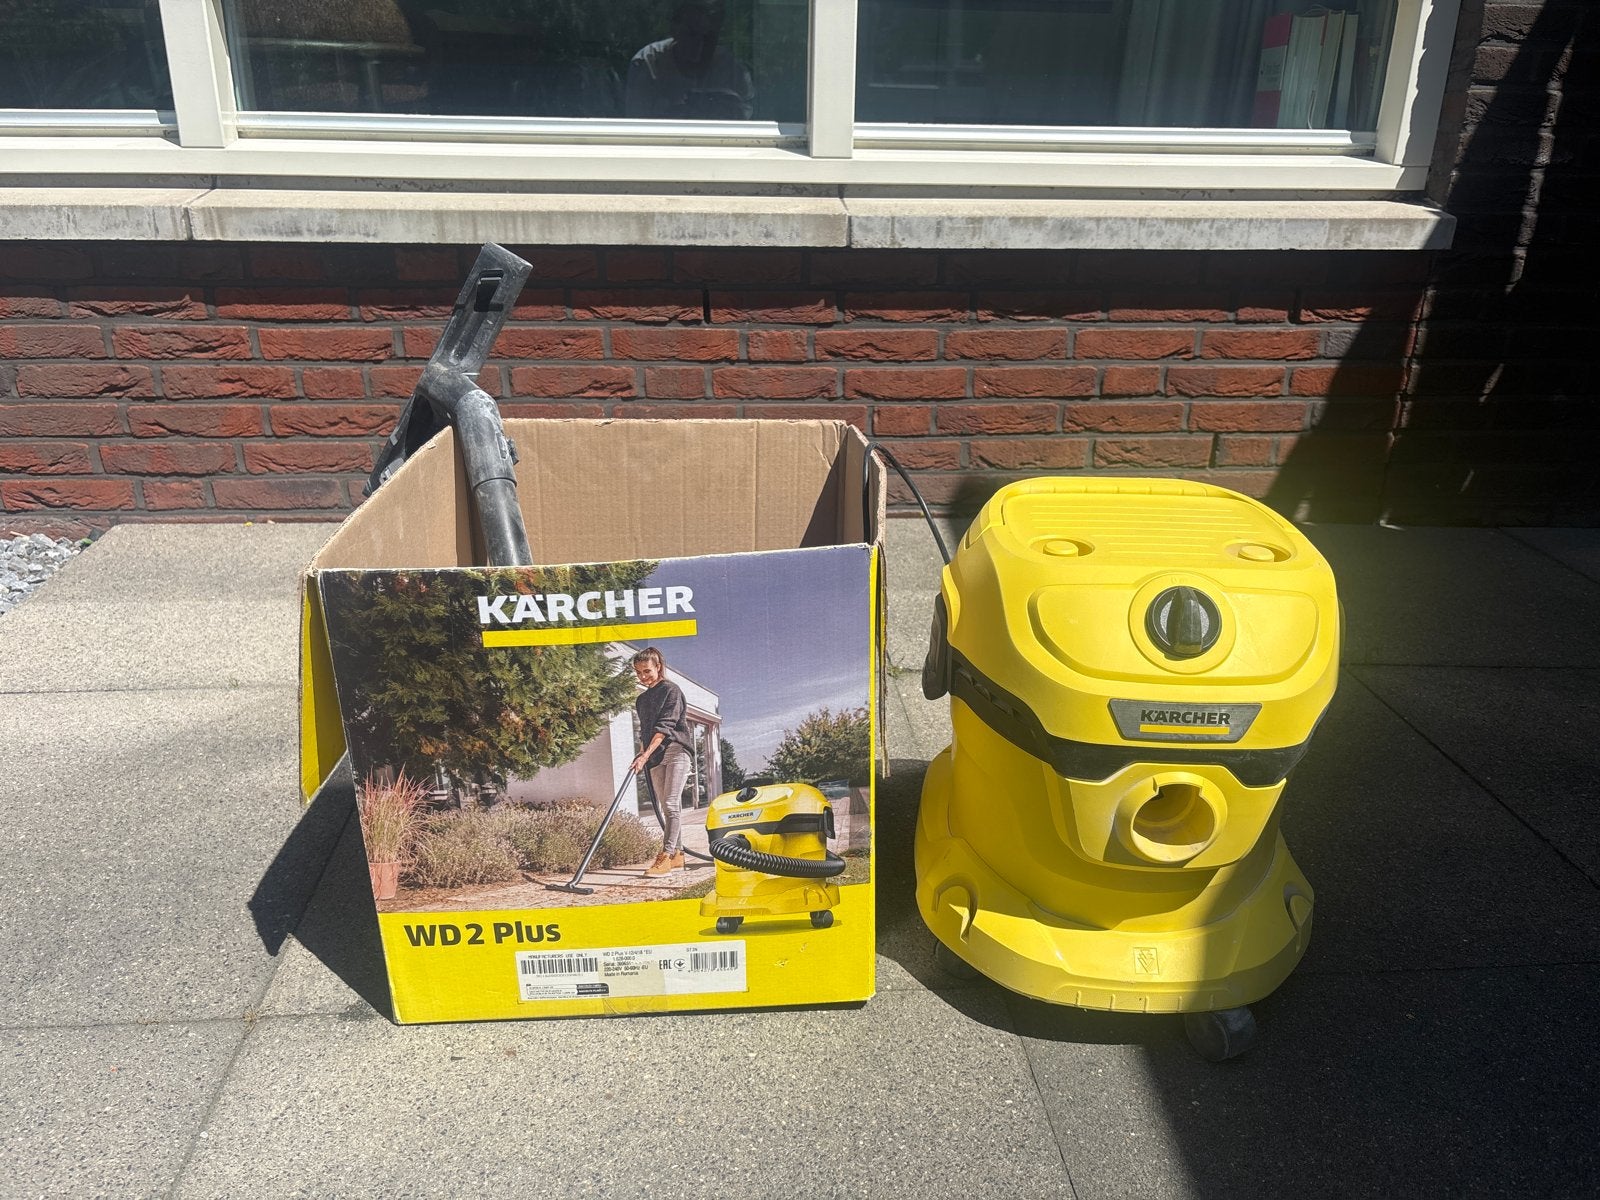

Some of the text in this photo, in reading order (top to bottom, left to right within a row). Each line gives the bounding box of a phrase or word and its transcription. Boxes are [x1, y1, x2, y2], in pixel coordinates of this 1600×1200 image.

[477, 585, 696, 624] KÄRCHER
[1140, 709, 1231, 725] KÄRCHER
[403, 920, 562, 947] WD 2 Plus
